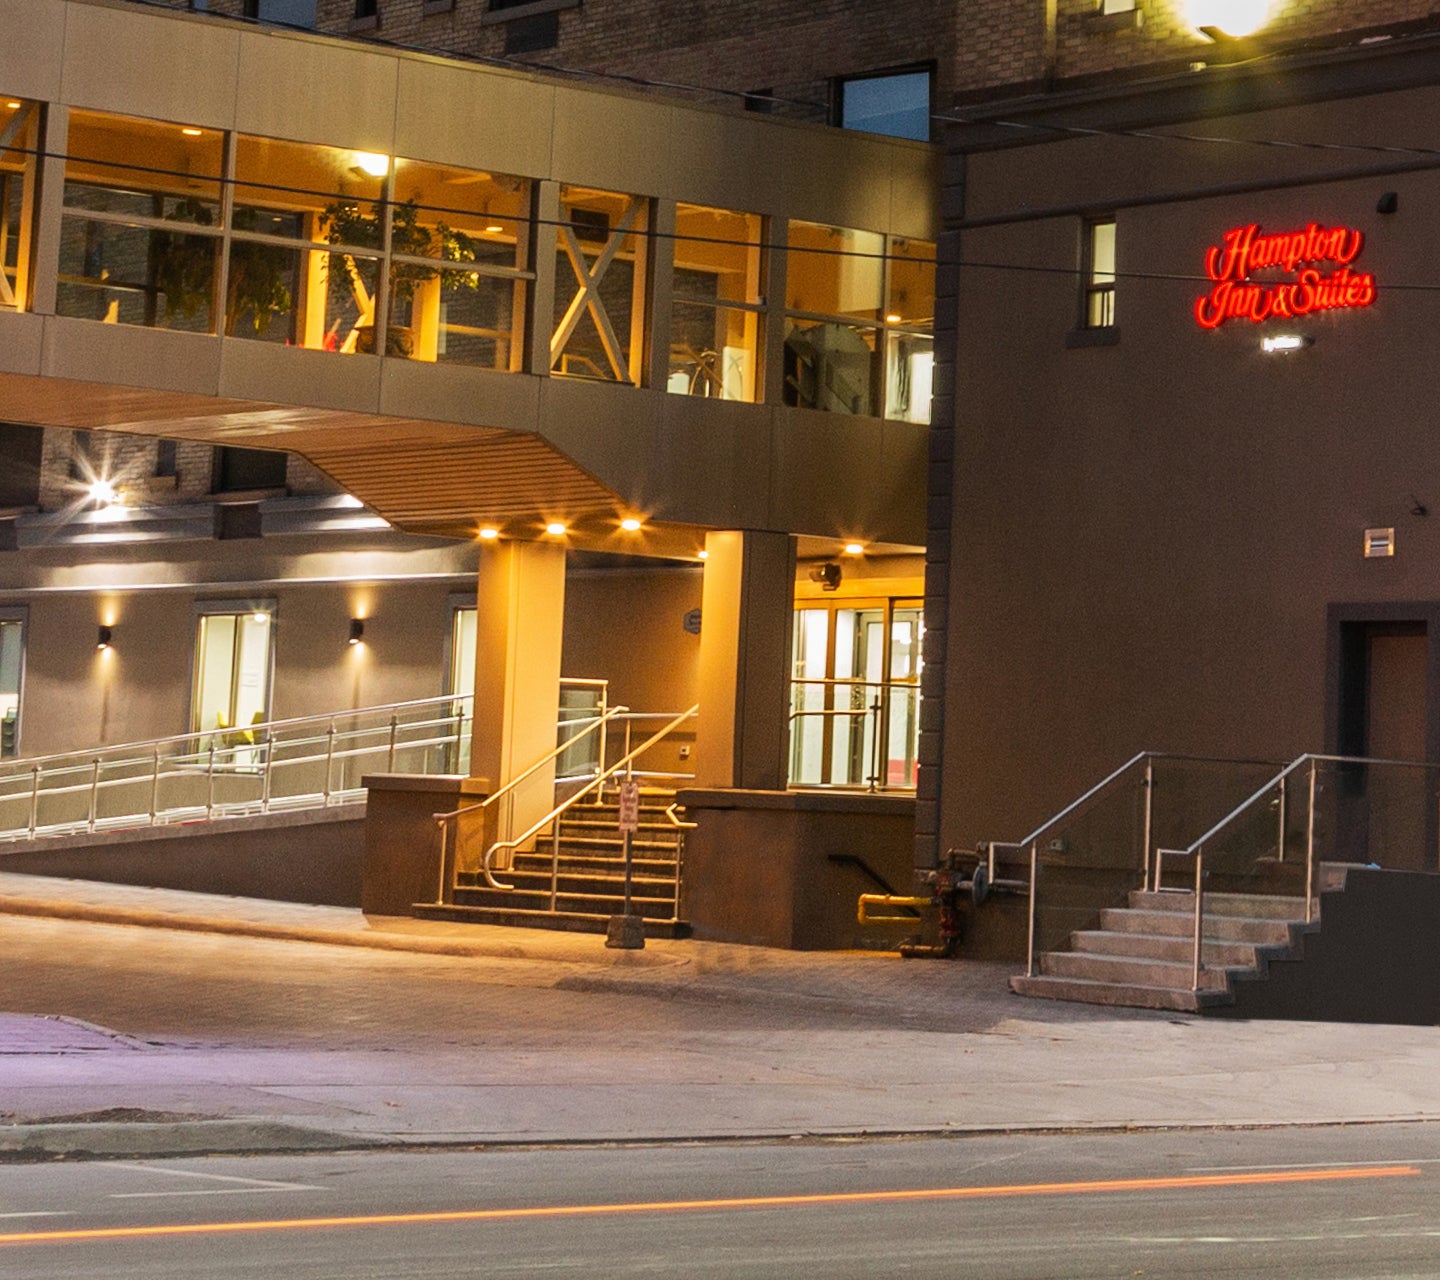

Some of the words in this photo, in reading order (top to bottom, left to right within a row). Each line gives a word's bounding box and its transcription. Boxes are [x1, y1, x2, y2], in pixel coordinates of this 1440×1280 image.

[1205, 222, 1362, 280] Hampton
[1195, 280, 1273, 328] Inn
[1271, 285, 1293, 318] &
[1289, 267, 1375, 314] Suites
